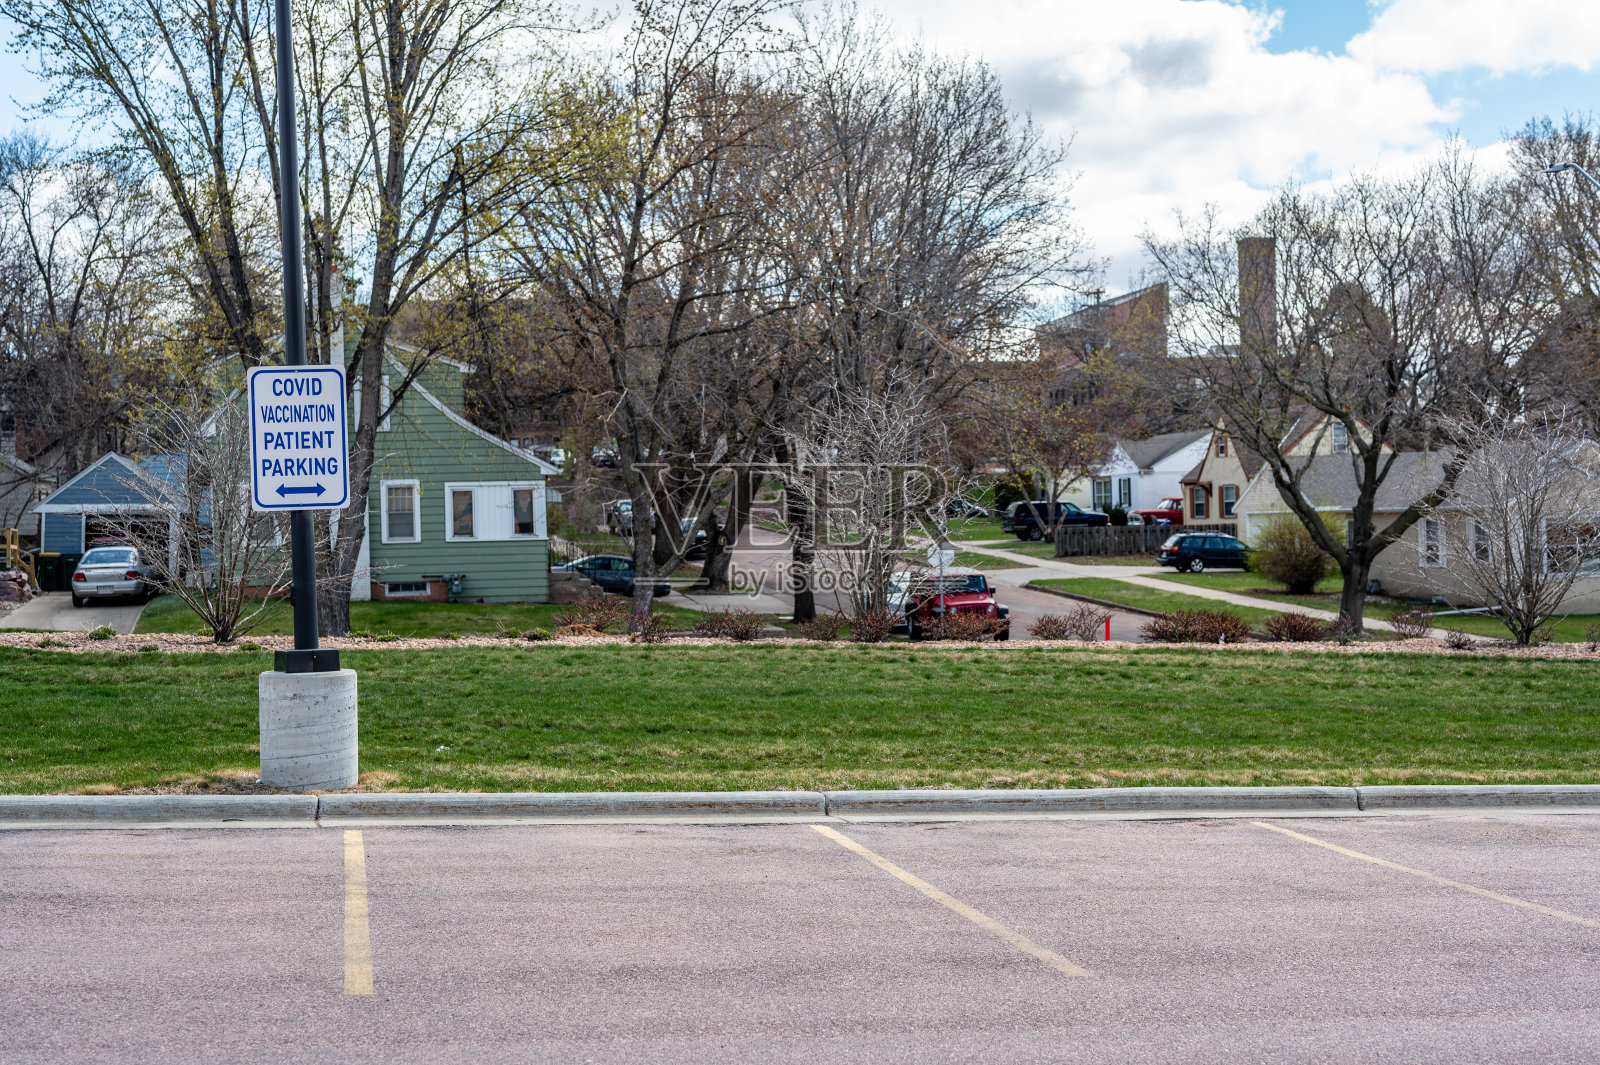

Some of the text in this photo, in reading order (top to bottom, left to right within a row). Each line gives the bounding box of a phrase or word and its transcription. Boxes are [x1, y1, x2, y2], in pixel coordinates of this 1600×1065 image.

[272, 378, 322, 396] COVID
[261, 404, 335, 423] VACCINATION
[264, 431, 334, 450] PATIENT
[262, 457, 338, 476] PARKING
